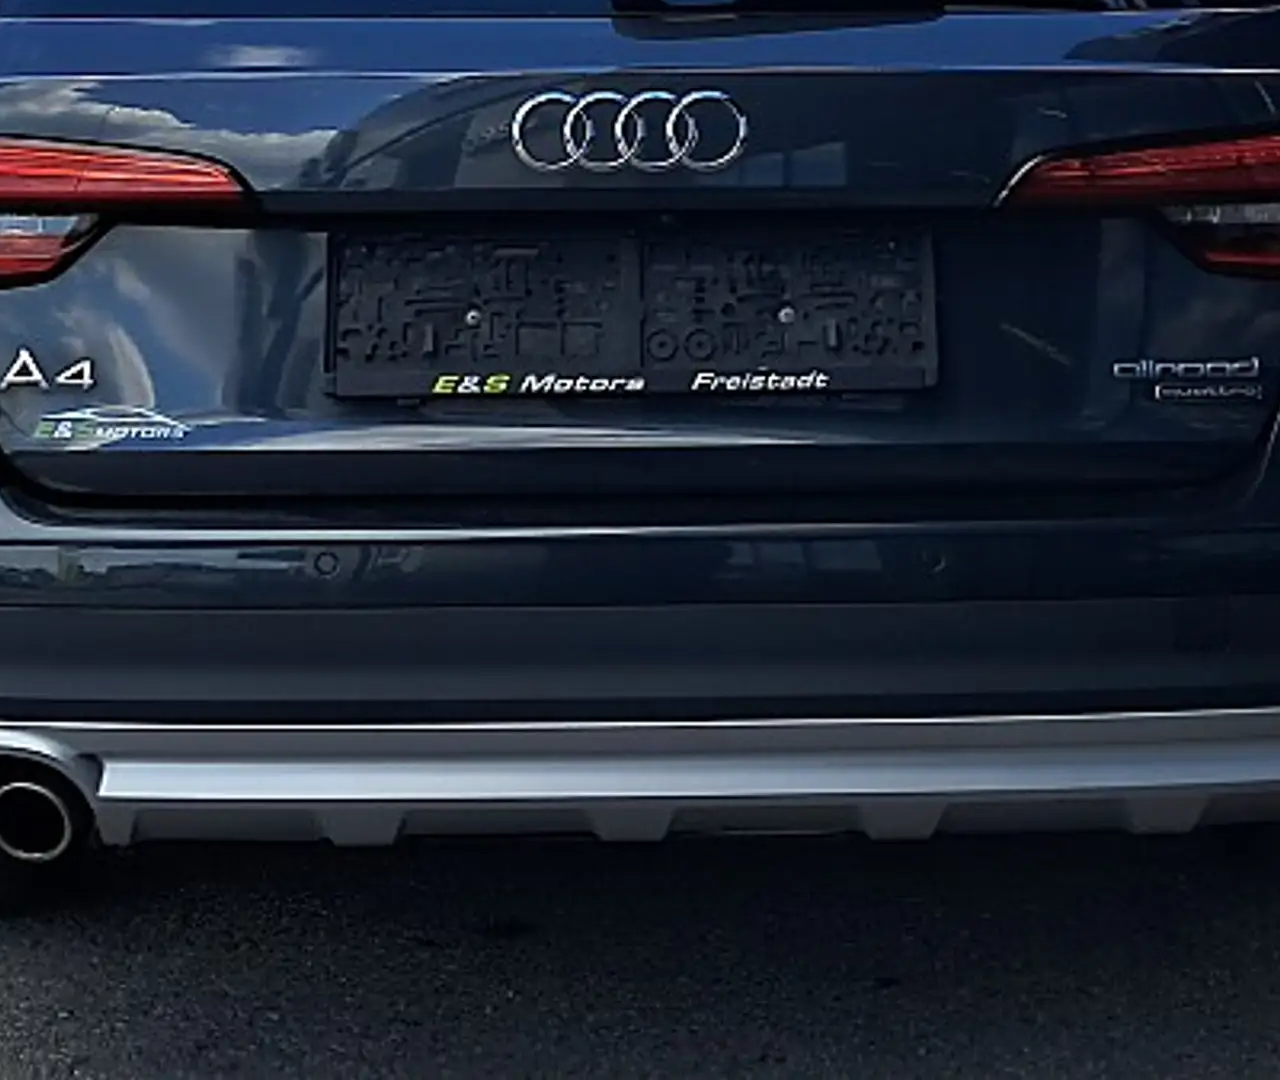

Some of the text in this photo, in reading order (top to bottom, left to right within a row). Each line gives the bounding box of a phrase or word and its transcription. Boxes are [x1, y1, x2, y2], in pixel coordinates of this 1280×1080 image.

[1113, 356, 1260, 378] allroad
[432, 370, 832, 394] E&S Motors Freistadt
